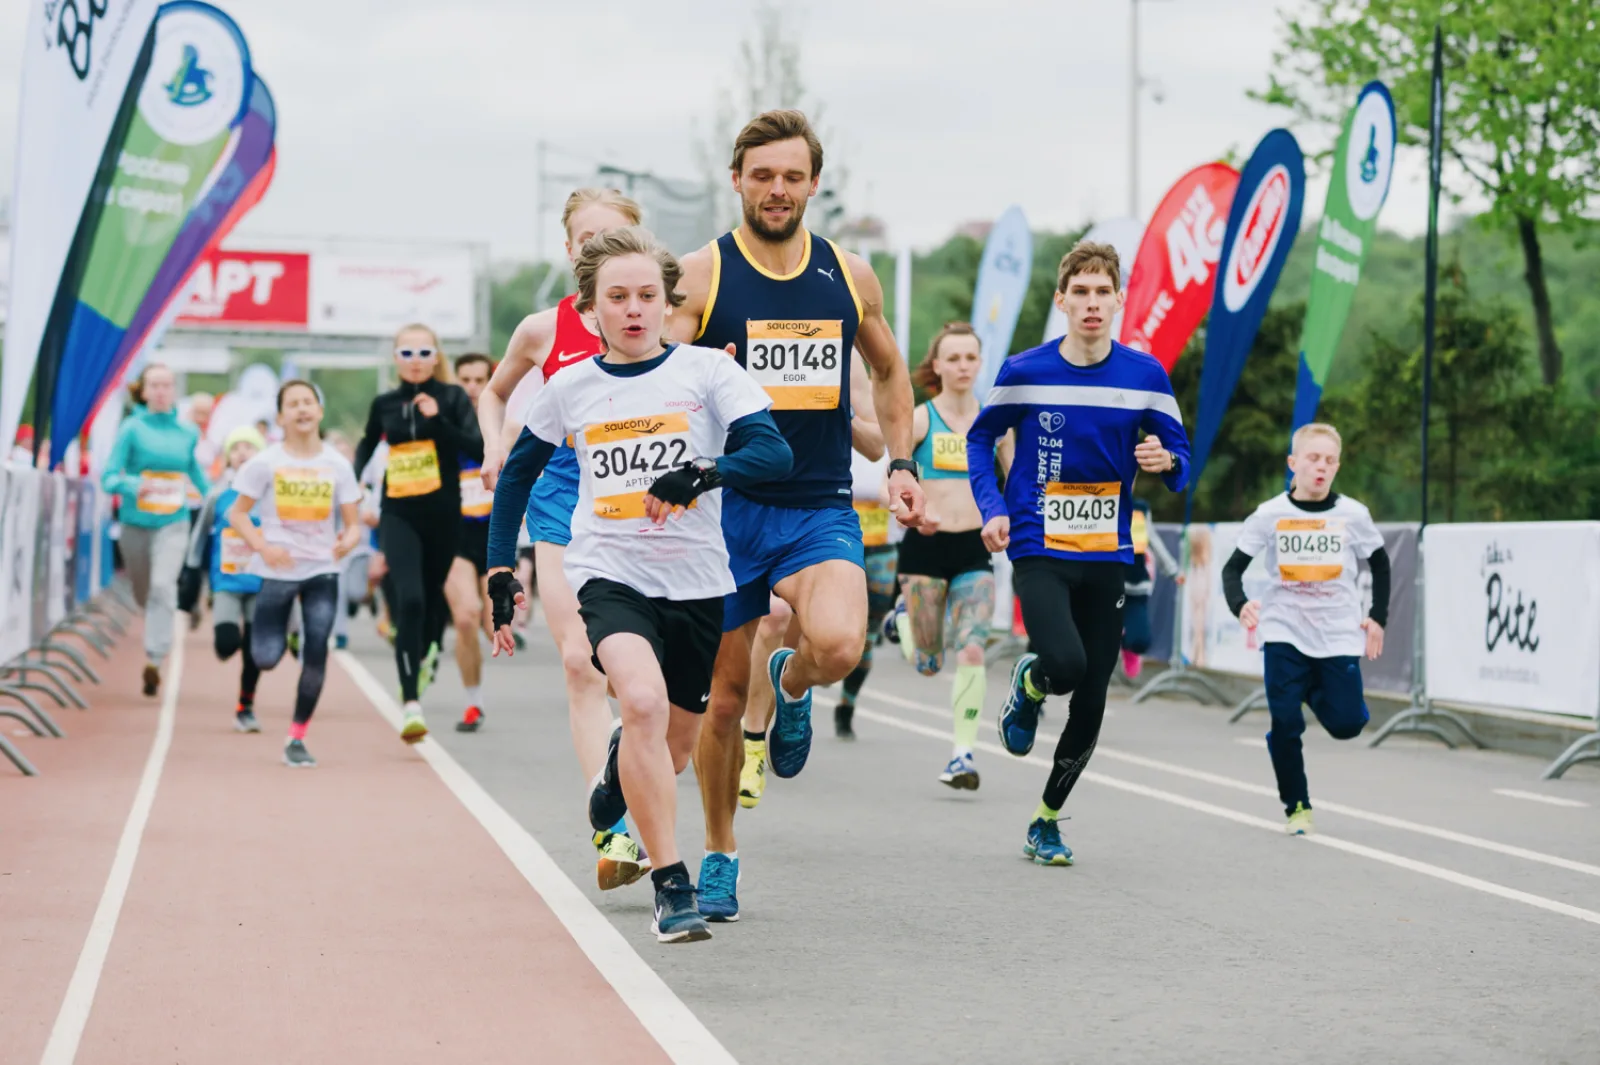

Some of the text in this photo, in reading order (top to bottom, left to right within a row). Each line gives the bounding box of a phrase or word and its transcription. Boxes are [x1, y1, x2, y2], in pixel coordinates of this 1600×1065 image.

[767, 322, 811, 332] saucony
[752, 343, 837, 371] 30148
[783, 373, 806, 382] EGOR
[664, 401, 697, 409] saucony
[604, 418, 652, 433] saucony
[1038, 435, 1063, 449] 12.04
[592, 438, 689, 479] 30422
[275, 480, 333, 498] 30232
[1048, 499, 1116, 521] 30403
[1279, 535, 1341, 553] 30485
[1486, 572, 1540, 653] Bite
